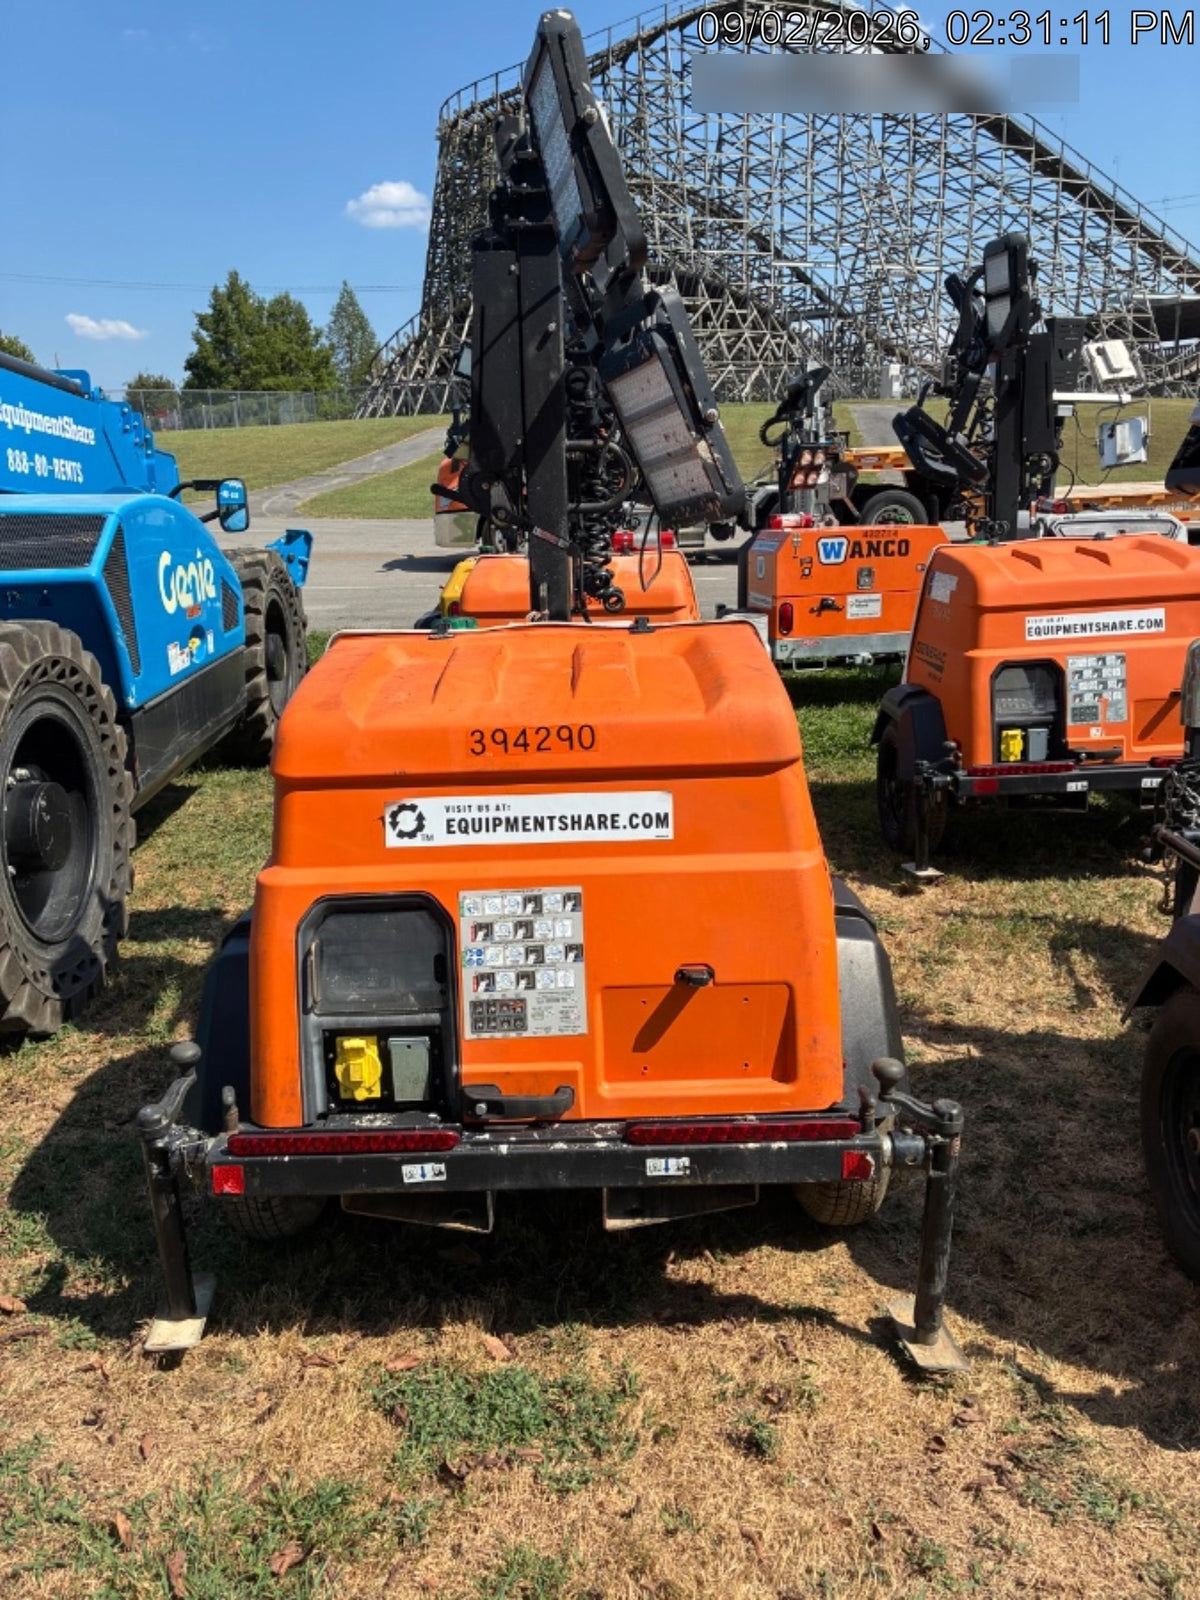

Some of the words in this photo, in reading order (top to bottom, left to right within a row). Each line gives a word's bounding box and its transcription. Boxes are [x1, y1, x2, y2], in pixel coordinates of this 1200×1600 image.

[7, 448, 84, 484] 888-80-RENTS
[820, 538, 910, 560] WANCO
[158, 547, 217, 614] Genie
[1027, 618, 1163, 637] EQUIPMENTSHARE.COM
[470, 724, 596, 756] 394290
[444, 804, 472, 813] VISIT
[477, 804, 490, 812] US
[494, 803, 512, 812] AT:
[445, 812, 670, 835] EQUIPMENTSHARE.COM
